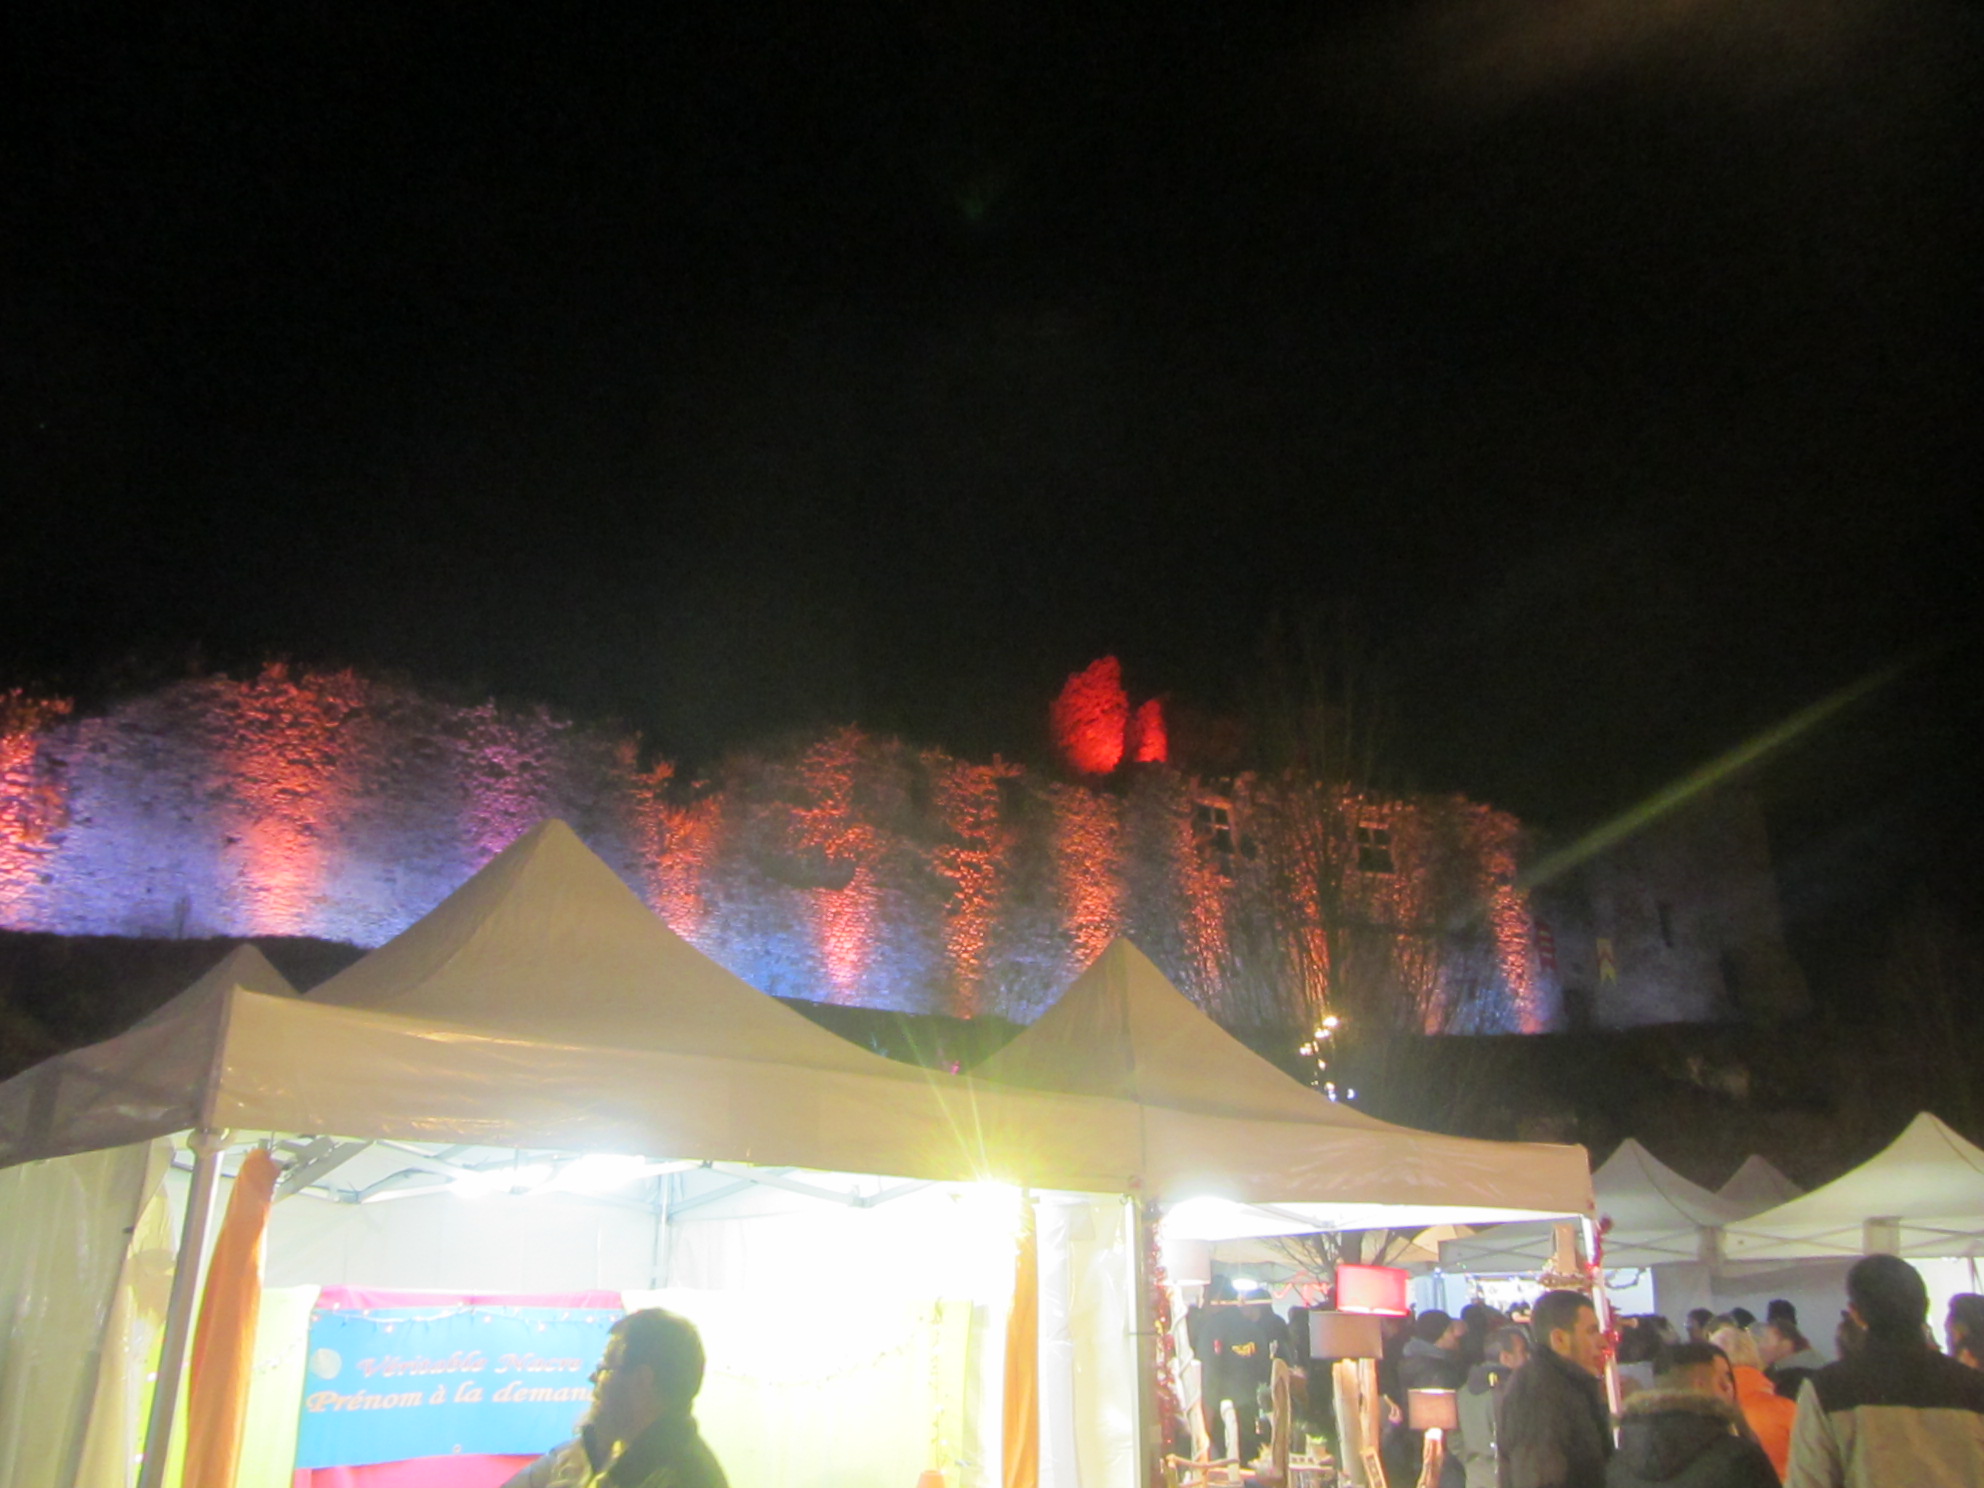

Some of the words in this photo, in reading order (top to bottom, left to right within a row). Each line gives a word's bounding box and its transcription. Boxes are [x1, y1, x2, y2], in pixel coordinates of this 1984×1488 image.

[306, 1389, 424, 1413] Prénom
[428, 1383, 447, 1405] à
[453, 1380, 485, 1403] la
